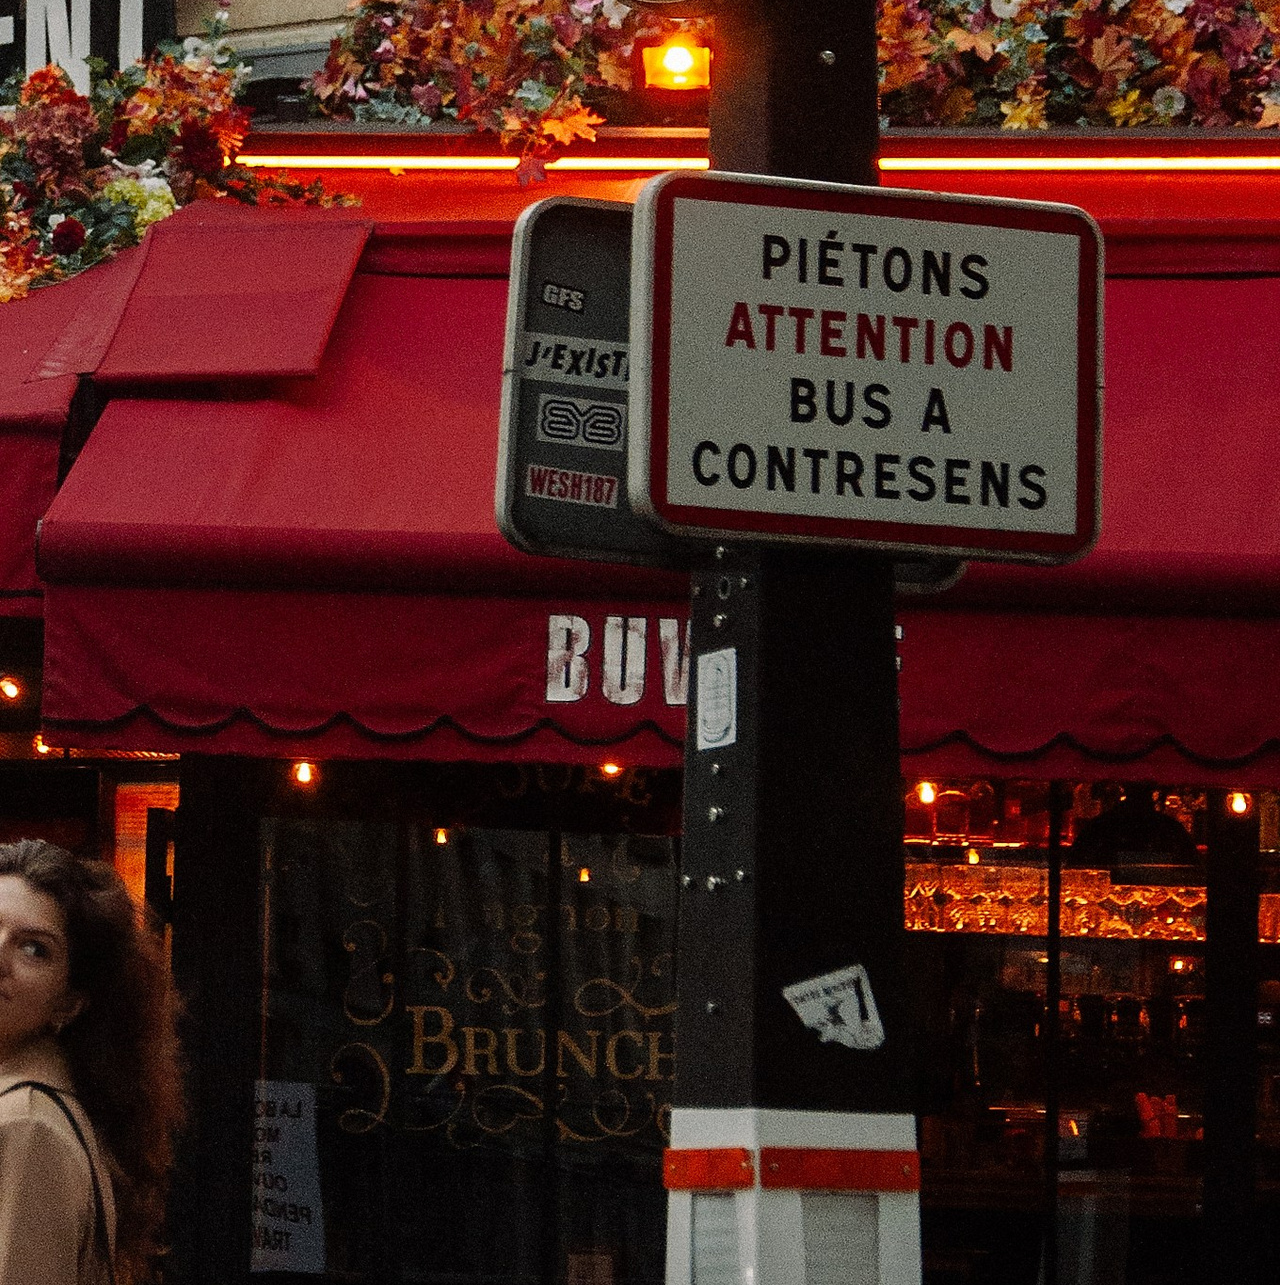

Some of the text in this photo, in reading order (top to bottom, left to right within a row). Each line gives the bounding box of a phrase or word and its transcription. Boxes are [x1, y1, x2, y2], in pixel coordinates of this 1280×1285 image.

[762, 231, 989, 300] PIÉTONS
[543, 284, 585, 311] GFS
[525, 339, 629, 382] J'EXIST
[725, 302, 1014, 372] ATTENTION
[790, 377, 951, 434] BUS A
[530, 467, 616, 506] WESH187
[692, 440, 1048, 511] CONTRESENS
